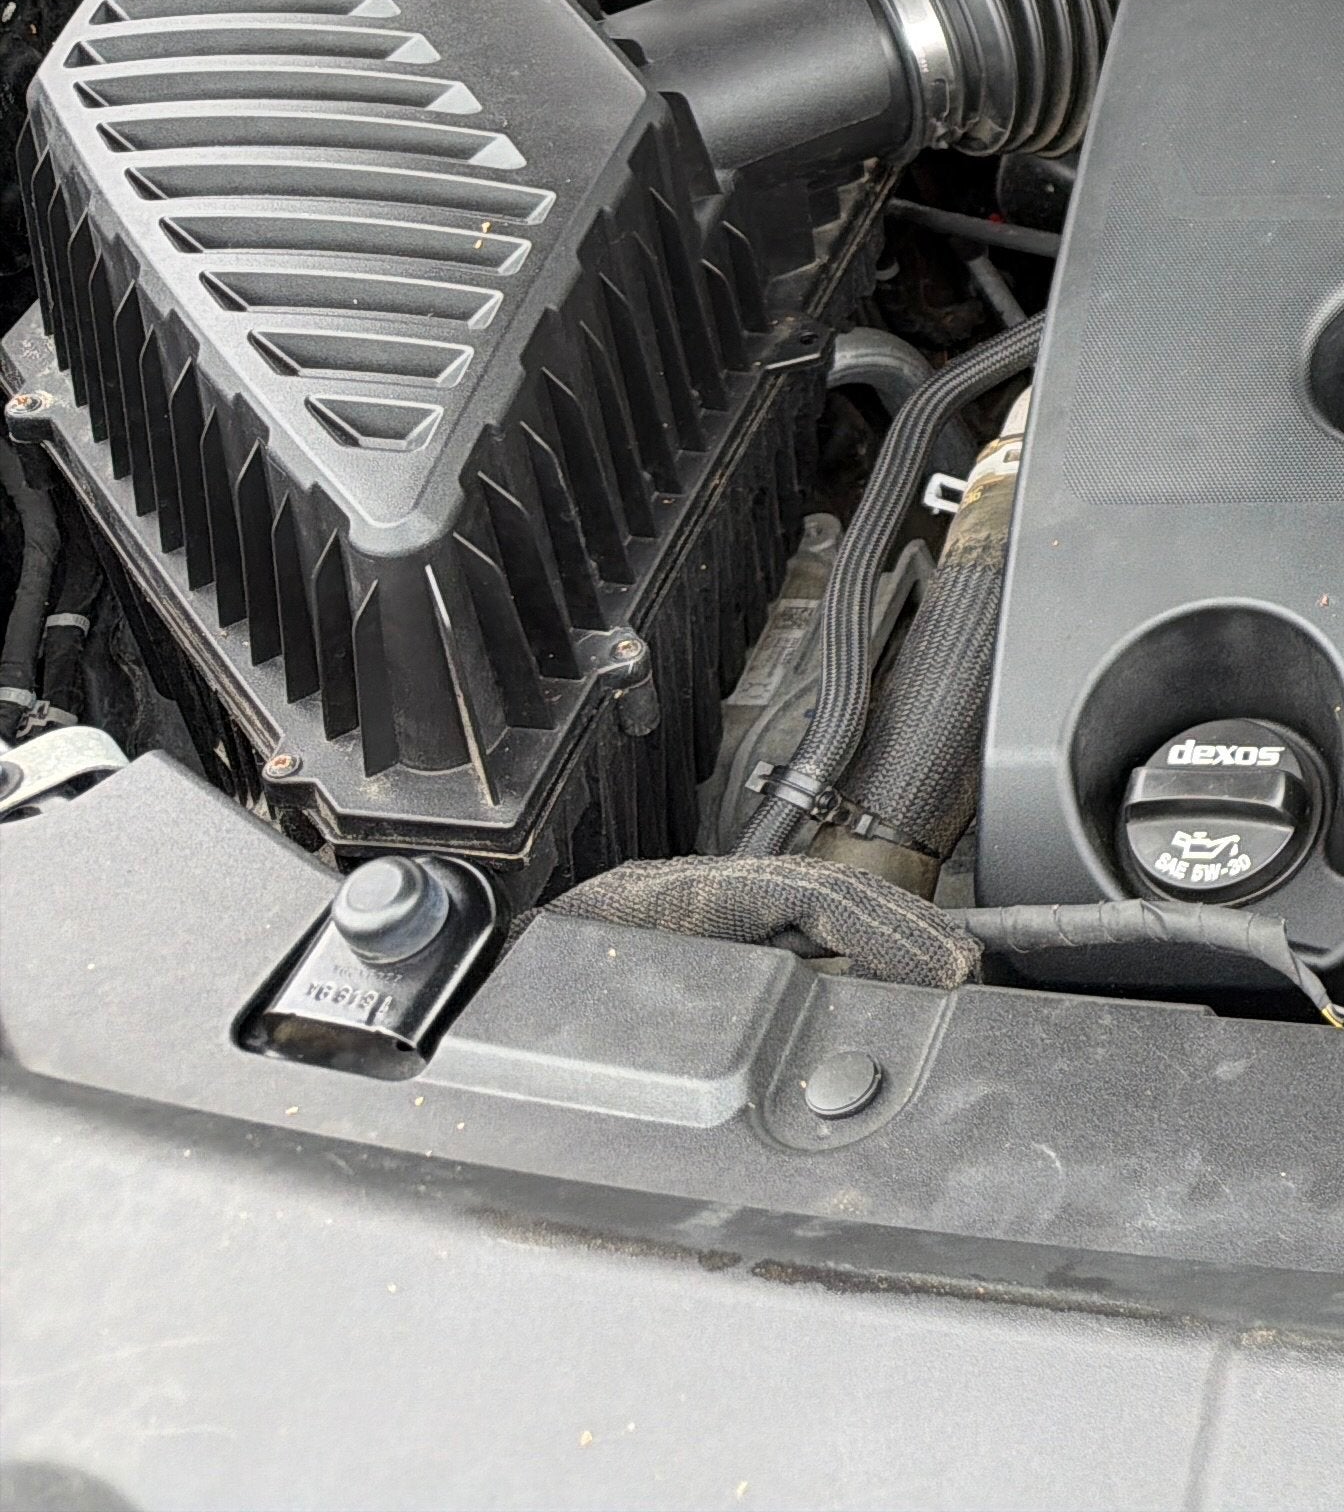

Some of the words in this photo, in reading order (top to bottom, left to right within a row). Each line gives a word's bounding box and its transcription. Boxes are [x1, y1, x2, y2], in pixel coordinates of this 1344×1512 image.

[1166, 739, 1286, 766] dexos
[1154, 851, 1190, 880] SAE
[1190, 853, 1252, 883] 5W-30
